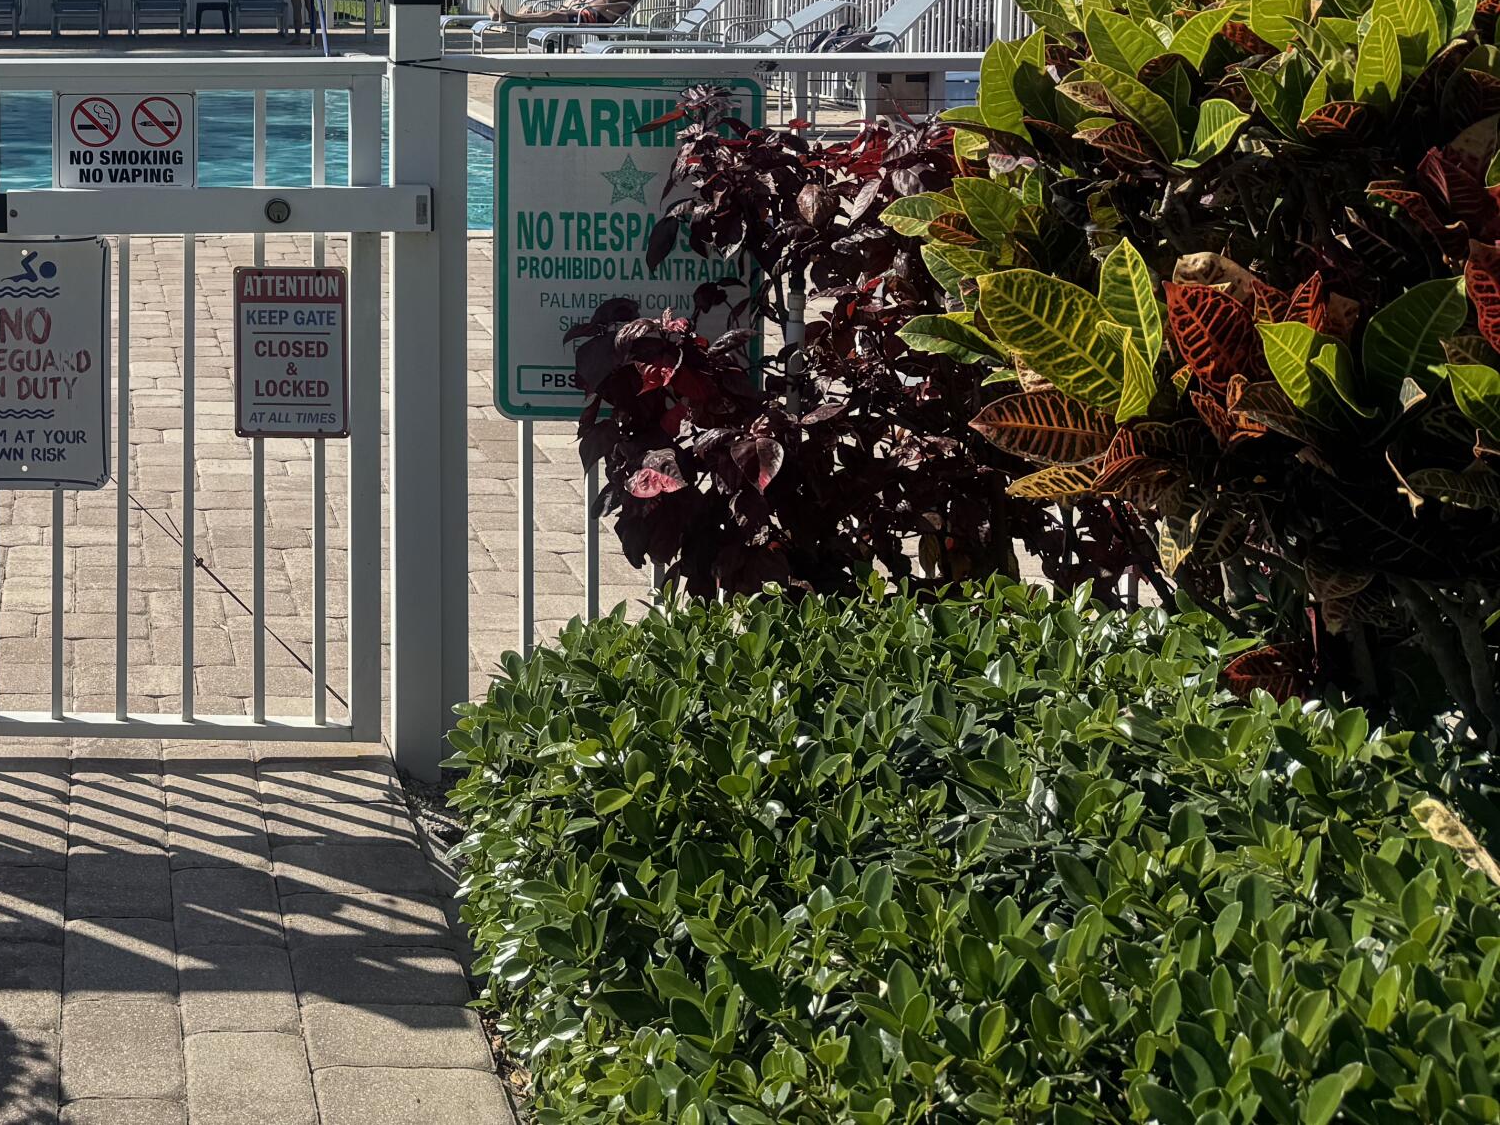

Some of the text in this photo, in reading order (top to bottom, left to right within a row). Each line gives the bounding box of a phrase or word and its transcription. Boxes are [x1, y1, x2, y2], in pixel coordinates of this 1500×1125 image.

[518, 97, 741, 148] WARNI
[70, 150, 184, 166] NO SMOKING
[79, 168, 174, 183] NO VAPING
[516, 211, 554, 251] NO
[516, 256, 617, 281] PROHIBIDO
[620, 257, 645, 281] LA
[243, 275, 340, 298] ATTENTION
[540, 292, 698, 310] PALM BEH COUN
[246, 309, 337, 326] KEEP GATE
[254, 340, 329, 358] CLOSED
[286, 361, 299, 376] &
[16, 376, 78, 401] DUTY
[254, 379, 330, 398] LOCKED
[249, 411, 337, 424] AT ALL TIMES
[14, 429, 35, 444] AT
[43, 429, 88, 445] YOUR
[31, 447, 67, 462] RISK
